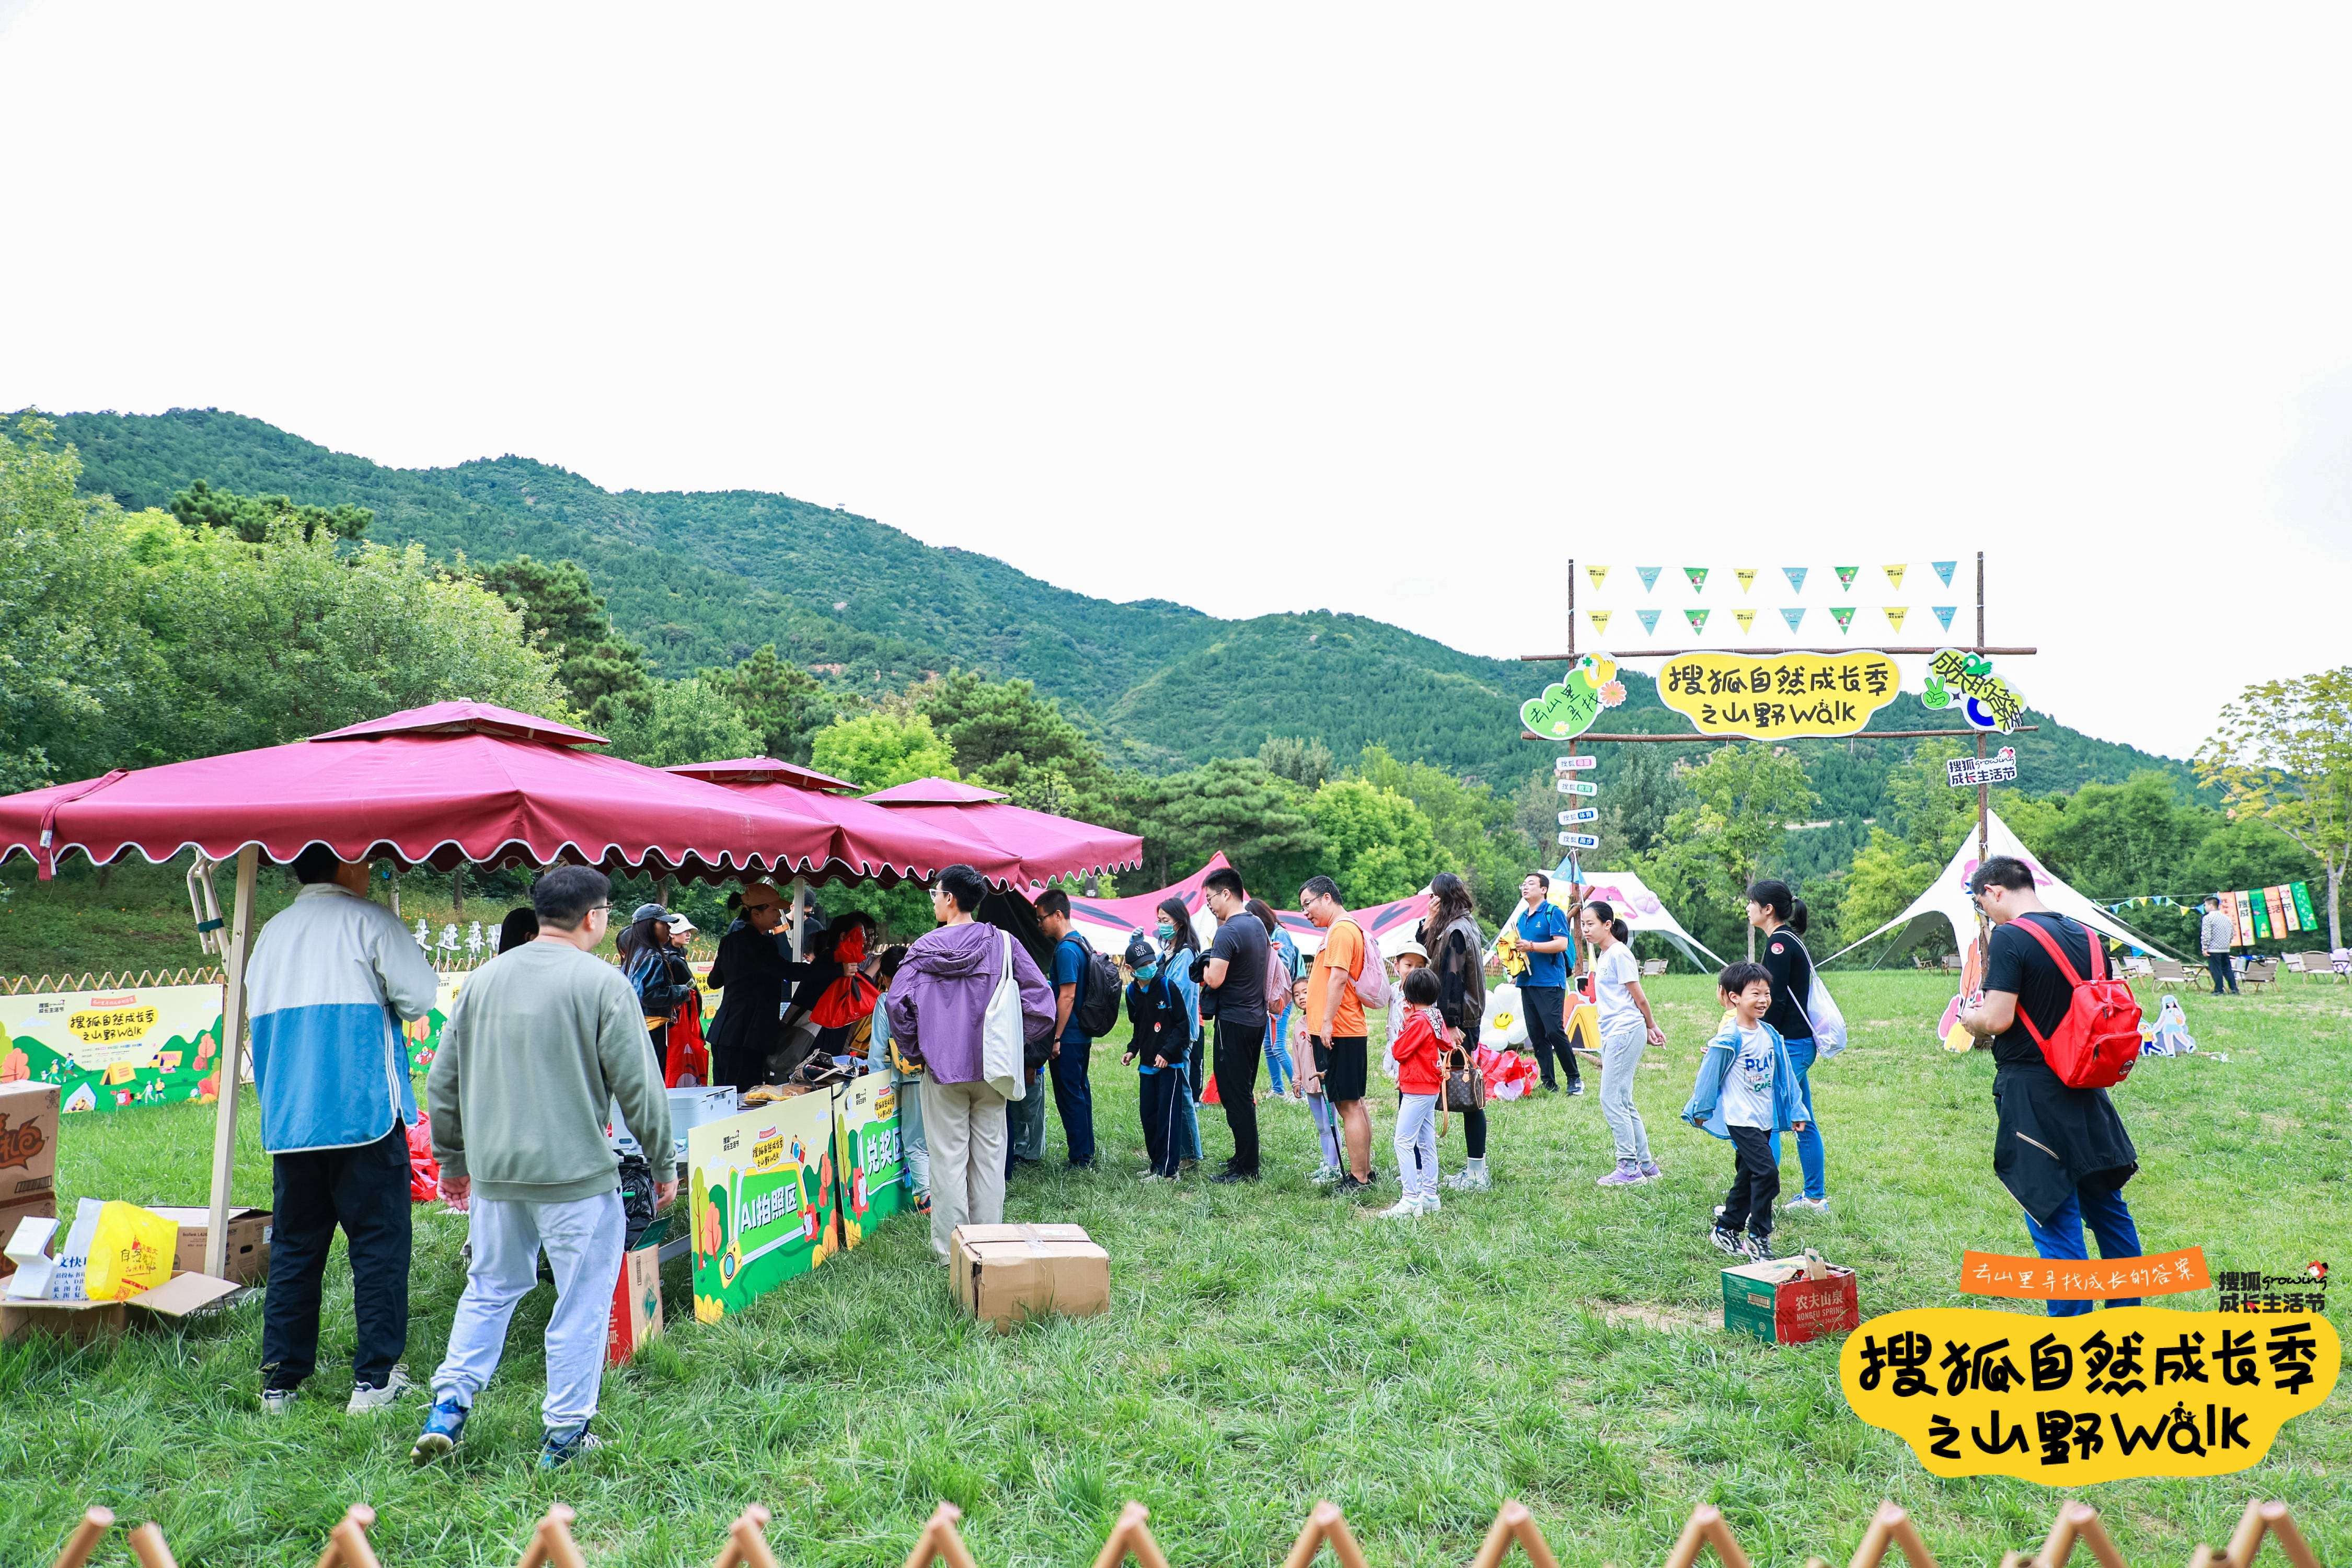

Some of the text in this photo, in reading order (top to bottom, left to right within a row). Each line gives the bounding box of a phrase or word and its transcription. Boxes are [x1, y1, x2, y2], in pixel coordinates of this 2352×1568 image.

[1668, 663, 1888, 696] 搜狐自然成长季
[1952, 766, 2015, 785] 成长生活节
[70, 1009, 154, 1029] 搜狐自然成长季
[753, 1137, 783, 1158] 搜狐自然成长季
[867, 1126, 903, 1177] 兑奖区
[741, 1182, 798, 1234] AI拍照区
[1795, 1289, 1844, 1311] 农夫山泉
[1797, 1306, 1843, 1321] NONGFU SPRING
